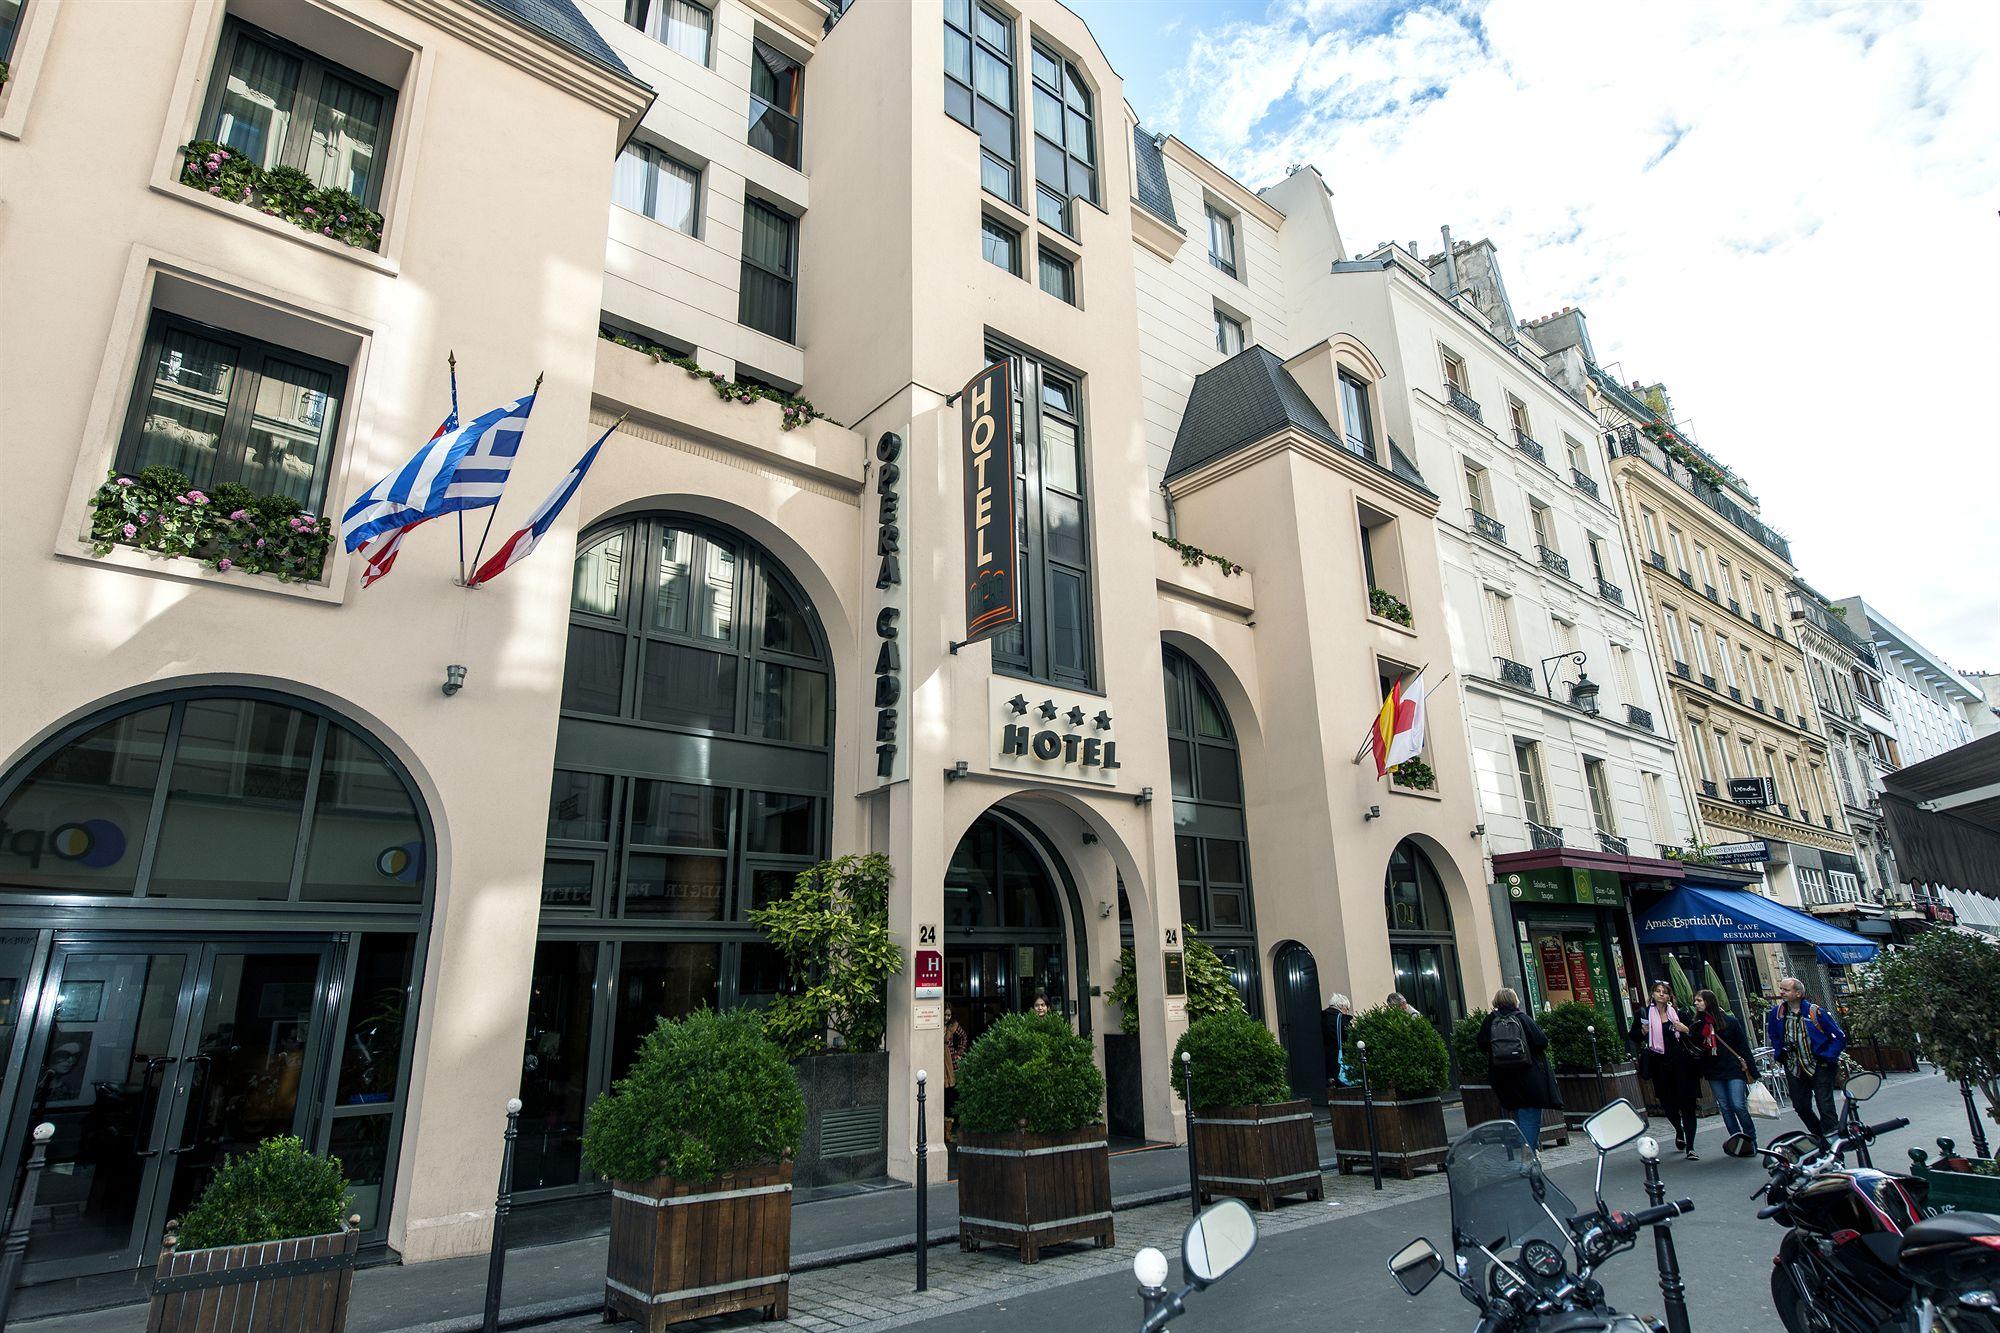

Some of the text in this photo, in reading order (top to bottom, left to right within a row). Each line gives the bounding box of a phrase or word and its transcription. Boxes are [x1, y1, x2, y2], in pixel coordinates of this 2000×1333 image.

[970, 376, 996, 568] HOTEL
[874, 431, 902, 778] OPERA CADET
[1002, 723, 1120, 769] HOTEL
[920, 925, 936, 943] 24
[1165, 929, 1178, 944] 24
[1723, 931, 1777, 939] RESTAURANT
[928, 957, 940, 971] H
